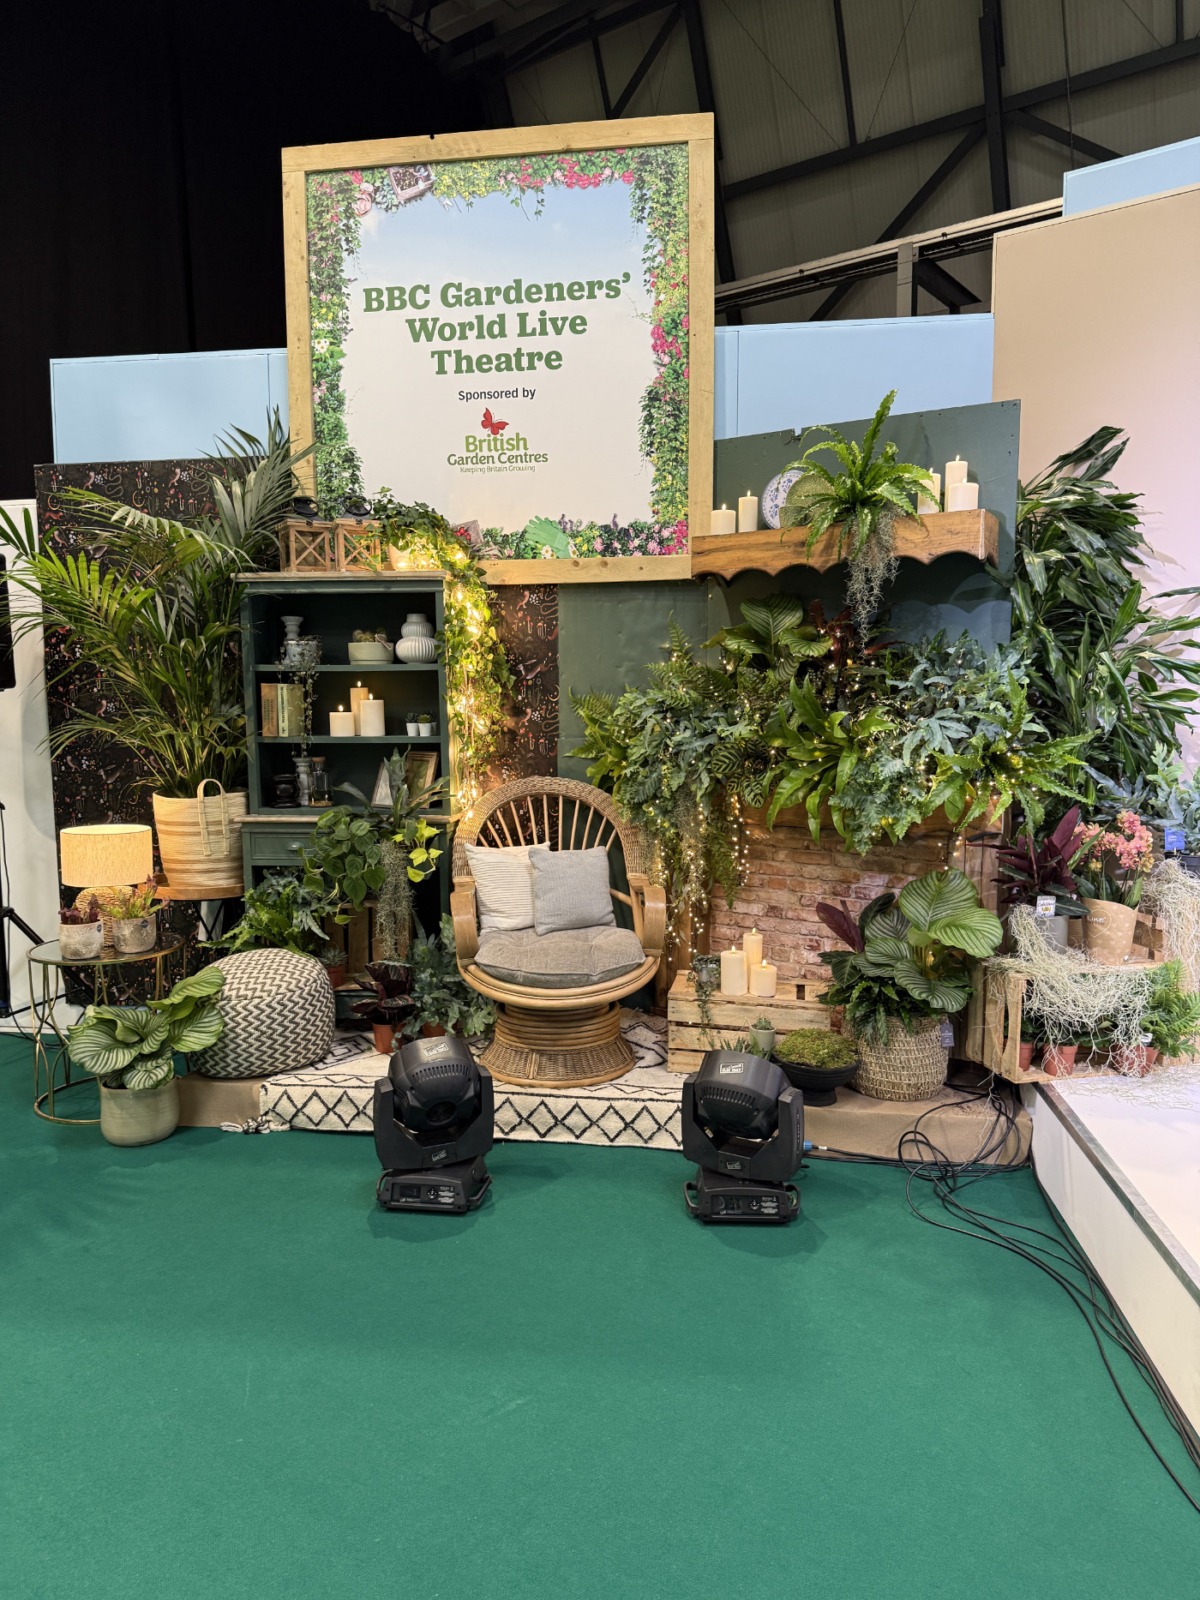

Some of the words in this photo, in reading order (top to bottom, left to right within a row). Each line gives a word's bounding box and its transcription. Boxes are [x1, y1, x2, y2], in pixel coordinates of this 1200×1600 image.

[363, 284, 430, 313] BBC
[405, 313, 507, 343] World
[517, 309, 588, 338] Live
[430, 347, 563, 375] Theatre
[458, 387, 519, 402] Sponsored
[522, 387, 536, 400] by
[465, 432, 529, 453] British
[447, 452, 495, 466] Garden
[498, 451, 549, 464] Centres
[460, 466, 486, 474] Keeping
[487, 465, 508, 473] Britain
[508, 464, 536, 472] Growing
